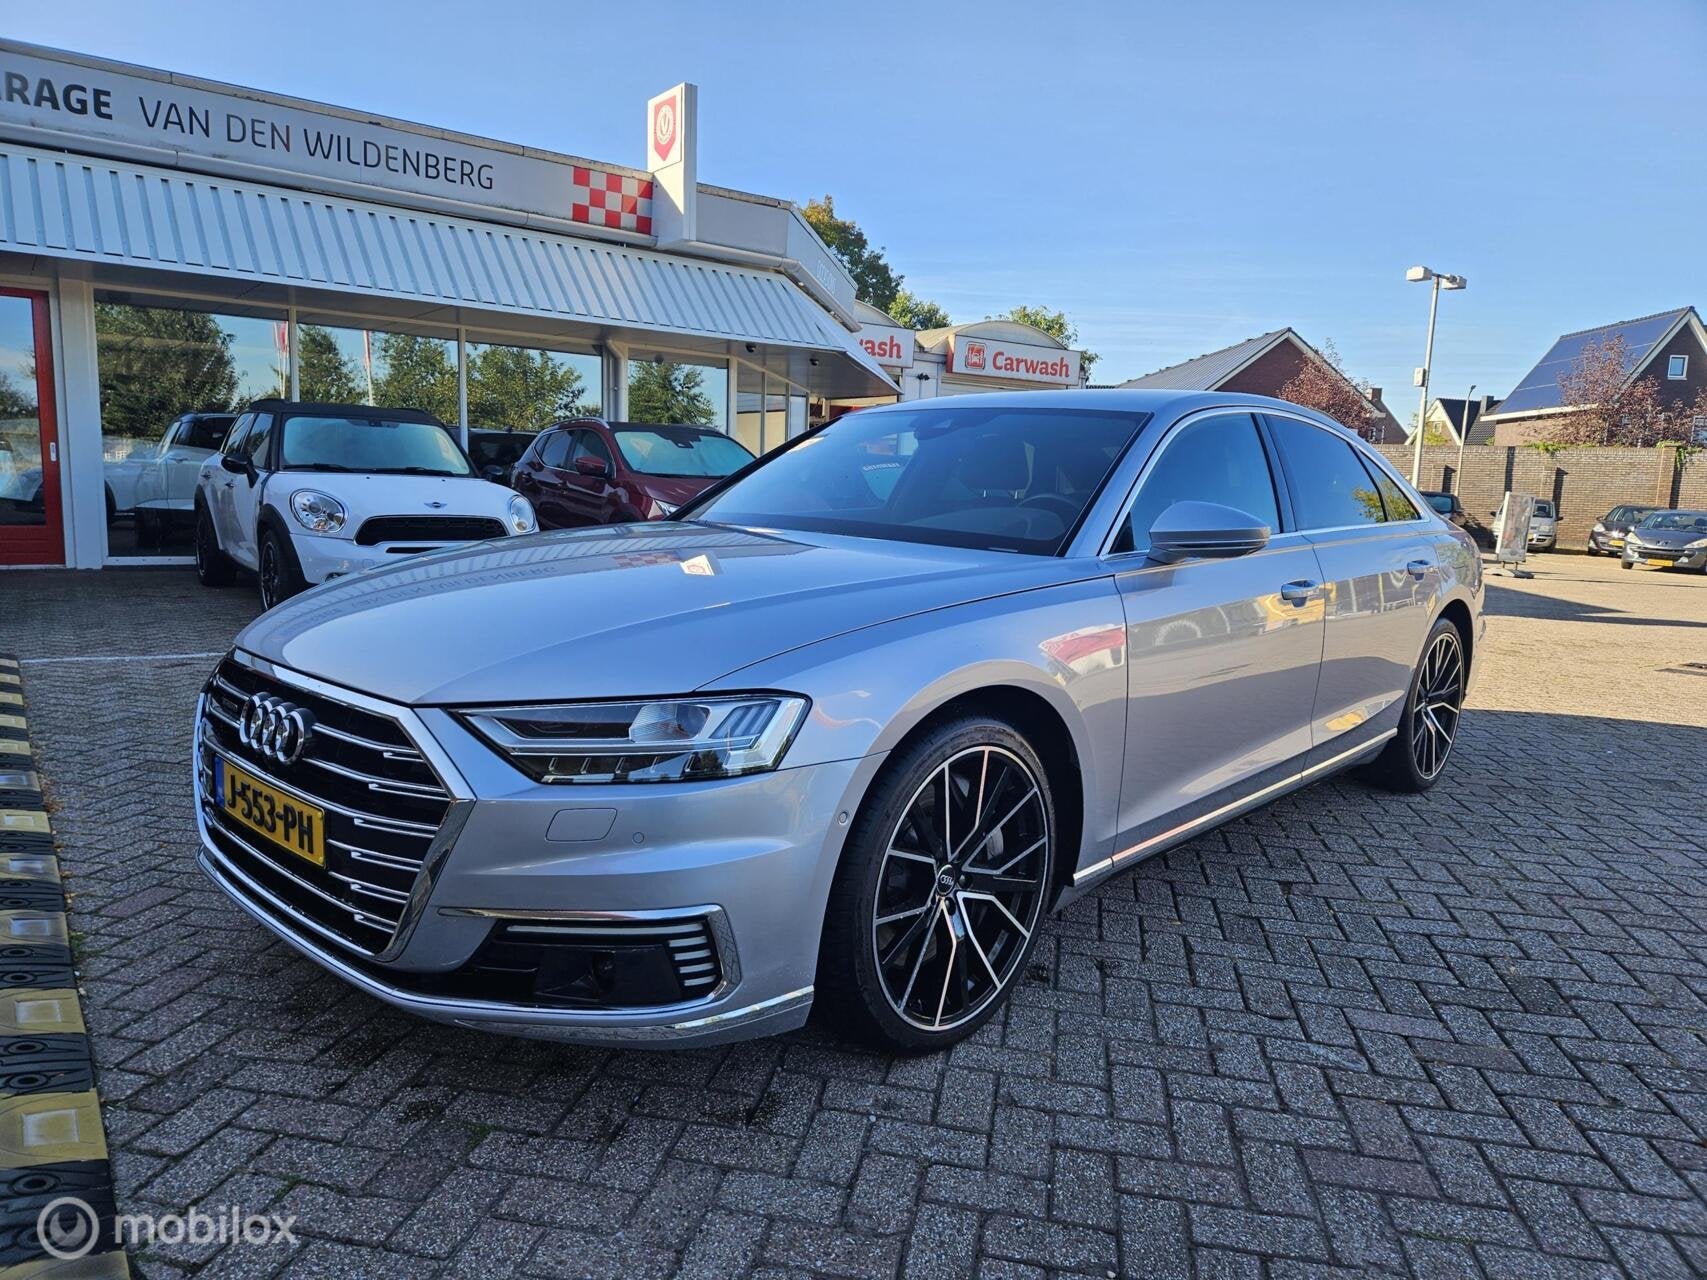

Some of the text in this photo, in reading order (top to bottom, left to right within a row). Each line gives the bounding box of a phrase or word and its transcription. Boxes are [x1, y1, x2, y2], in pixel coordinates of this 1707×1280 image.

[0, 71, 494, 190] RAGE VAN DEN WILDENBERG
[859, 335, 902, 359] ash
[992, 351, 1070, 378] Carwash
[228, 774, 314, 855] J-553-PH
